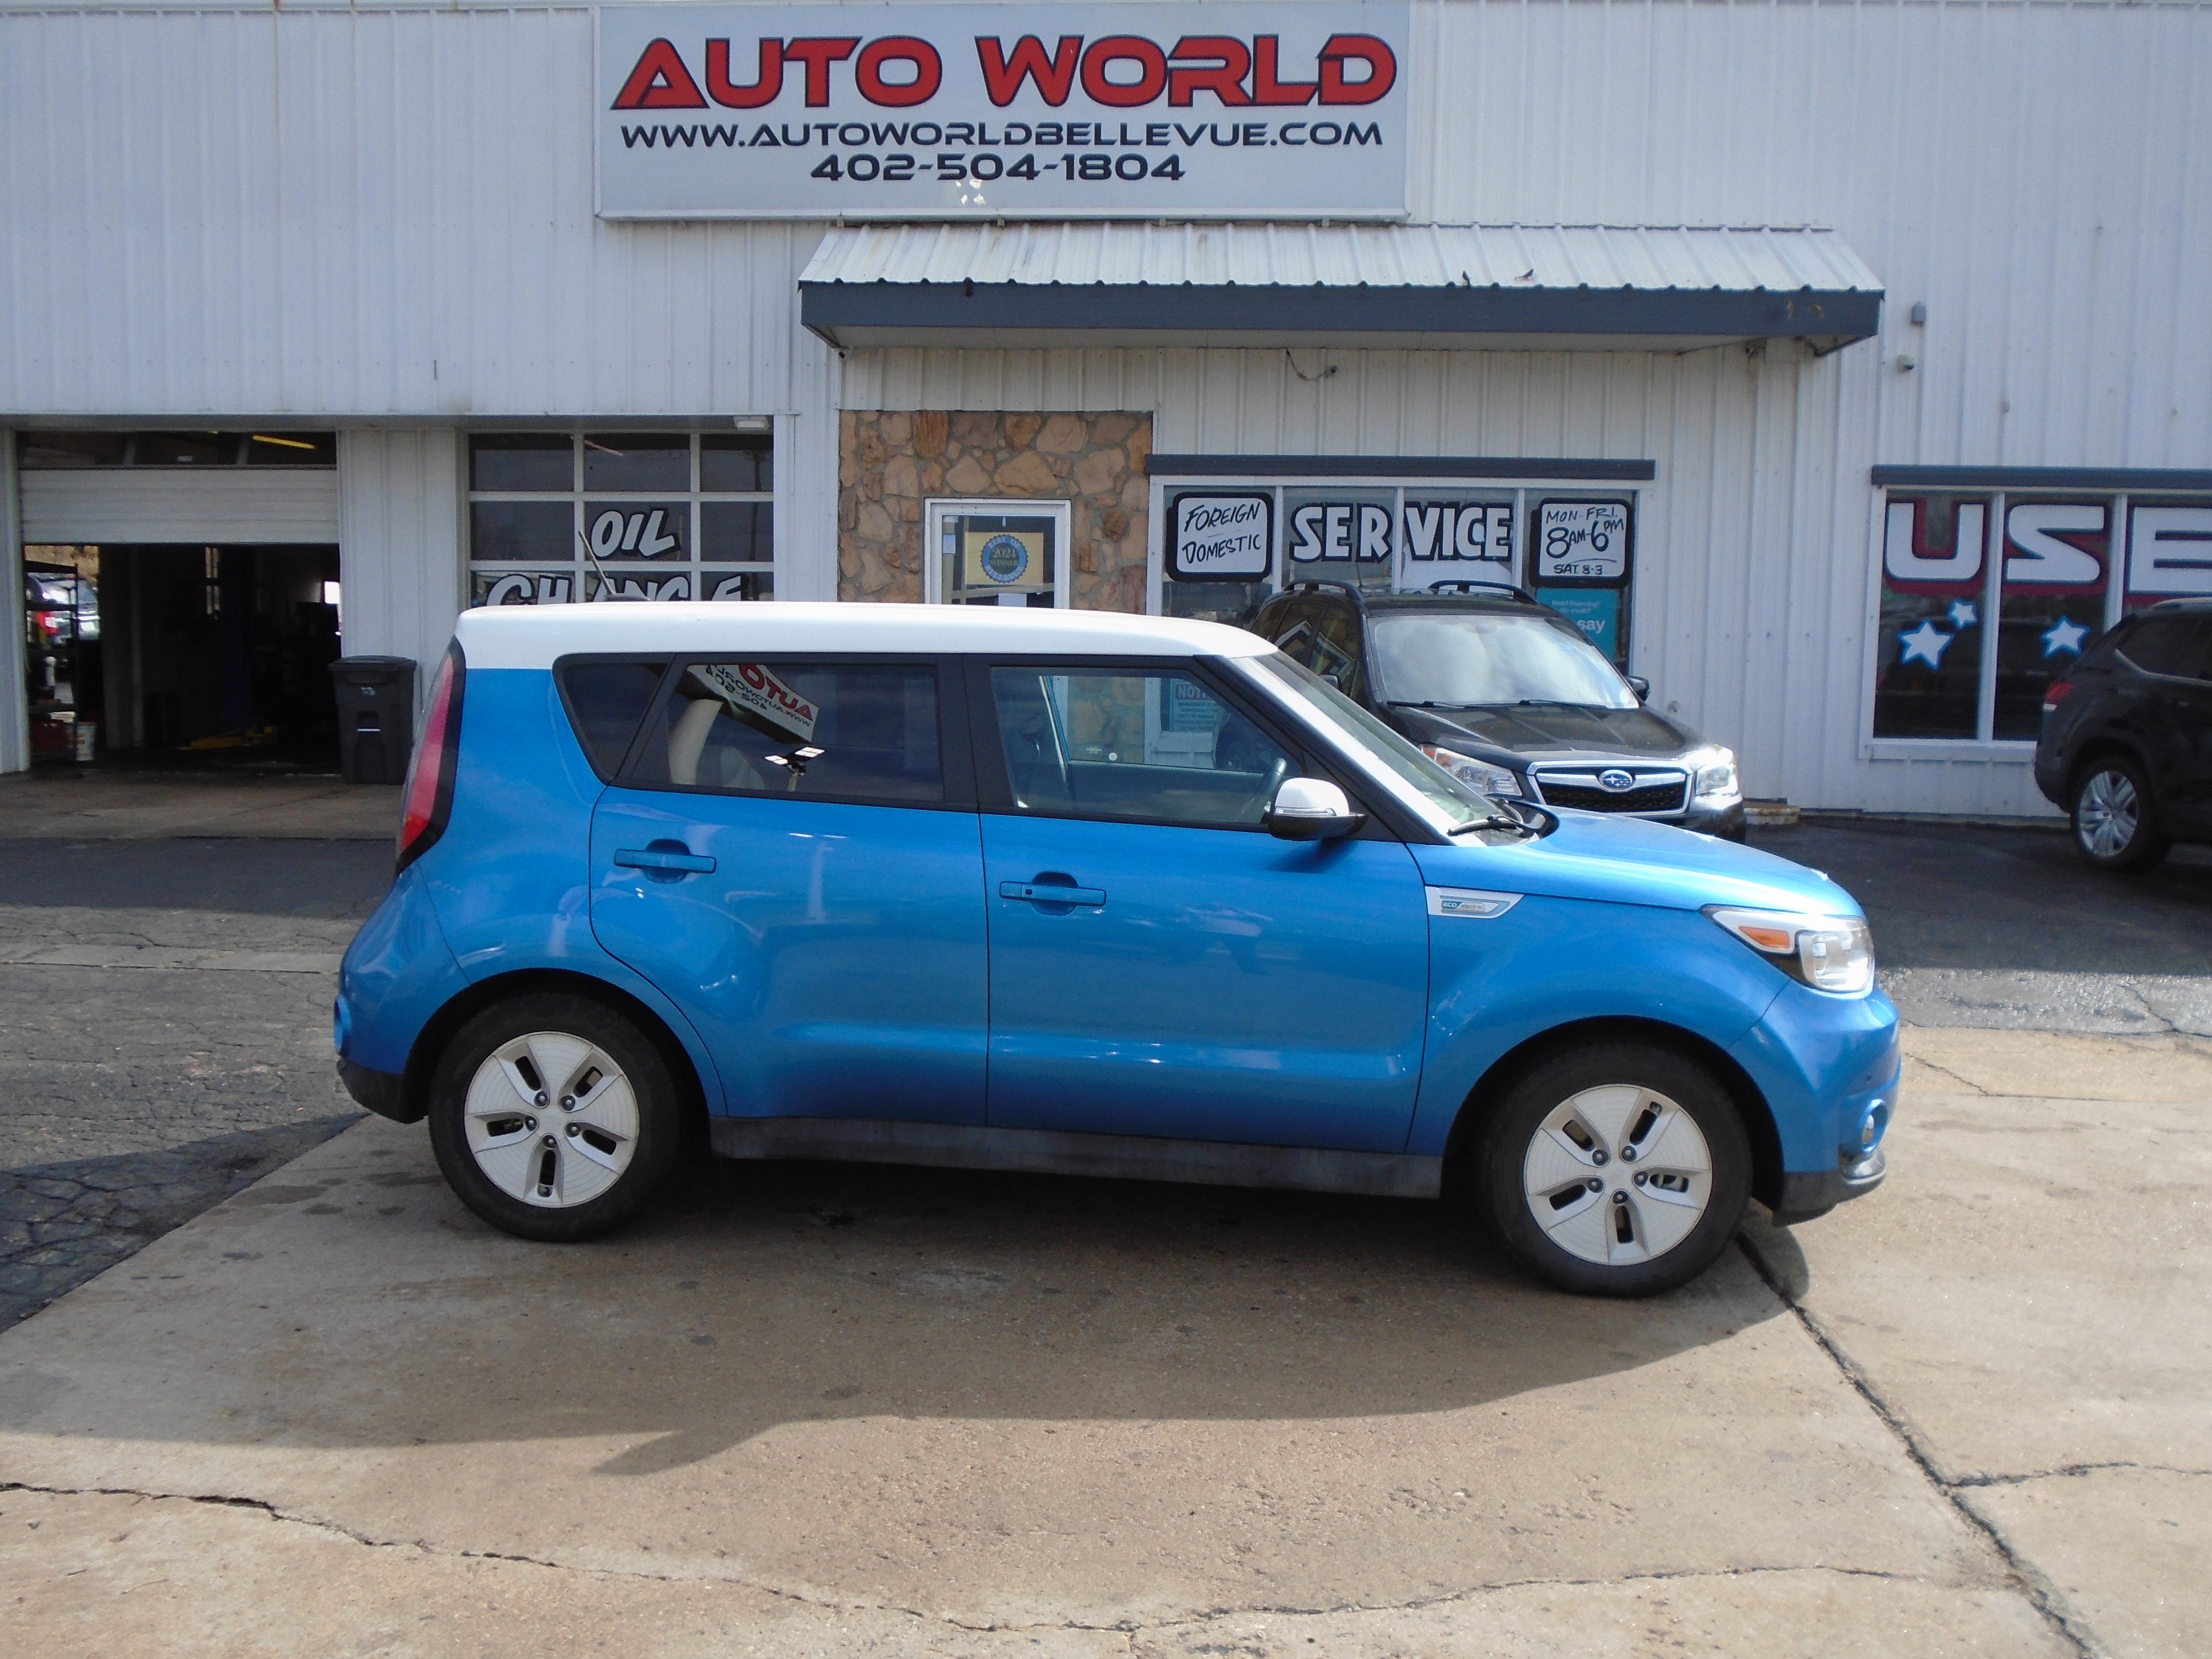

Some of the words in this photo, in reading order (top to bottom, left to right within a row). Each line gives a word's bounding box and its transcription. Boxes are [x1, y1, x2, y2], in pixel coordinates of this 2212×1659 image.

[610, 36, 942, 110] AUTO
[975, 33, 1397, 108] WORLD
[621, 122, 1382, 149] WWW.AUTOWORLDBELLEVUE.COM
[810, 153, 1185, 182] 402-504-1804
[1183, 502, 1261, 532] FOREIGN
[590, 509, 679, 558] OIL
[1291, 503, 1513, 562] SERVICE
[1182, 534, 1261, 564] DOMESTIC
[1577, 619, 1606, 634] say
